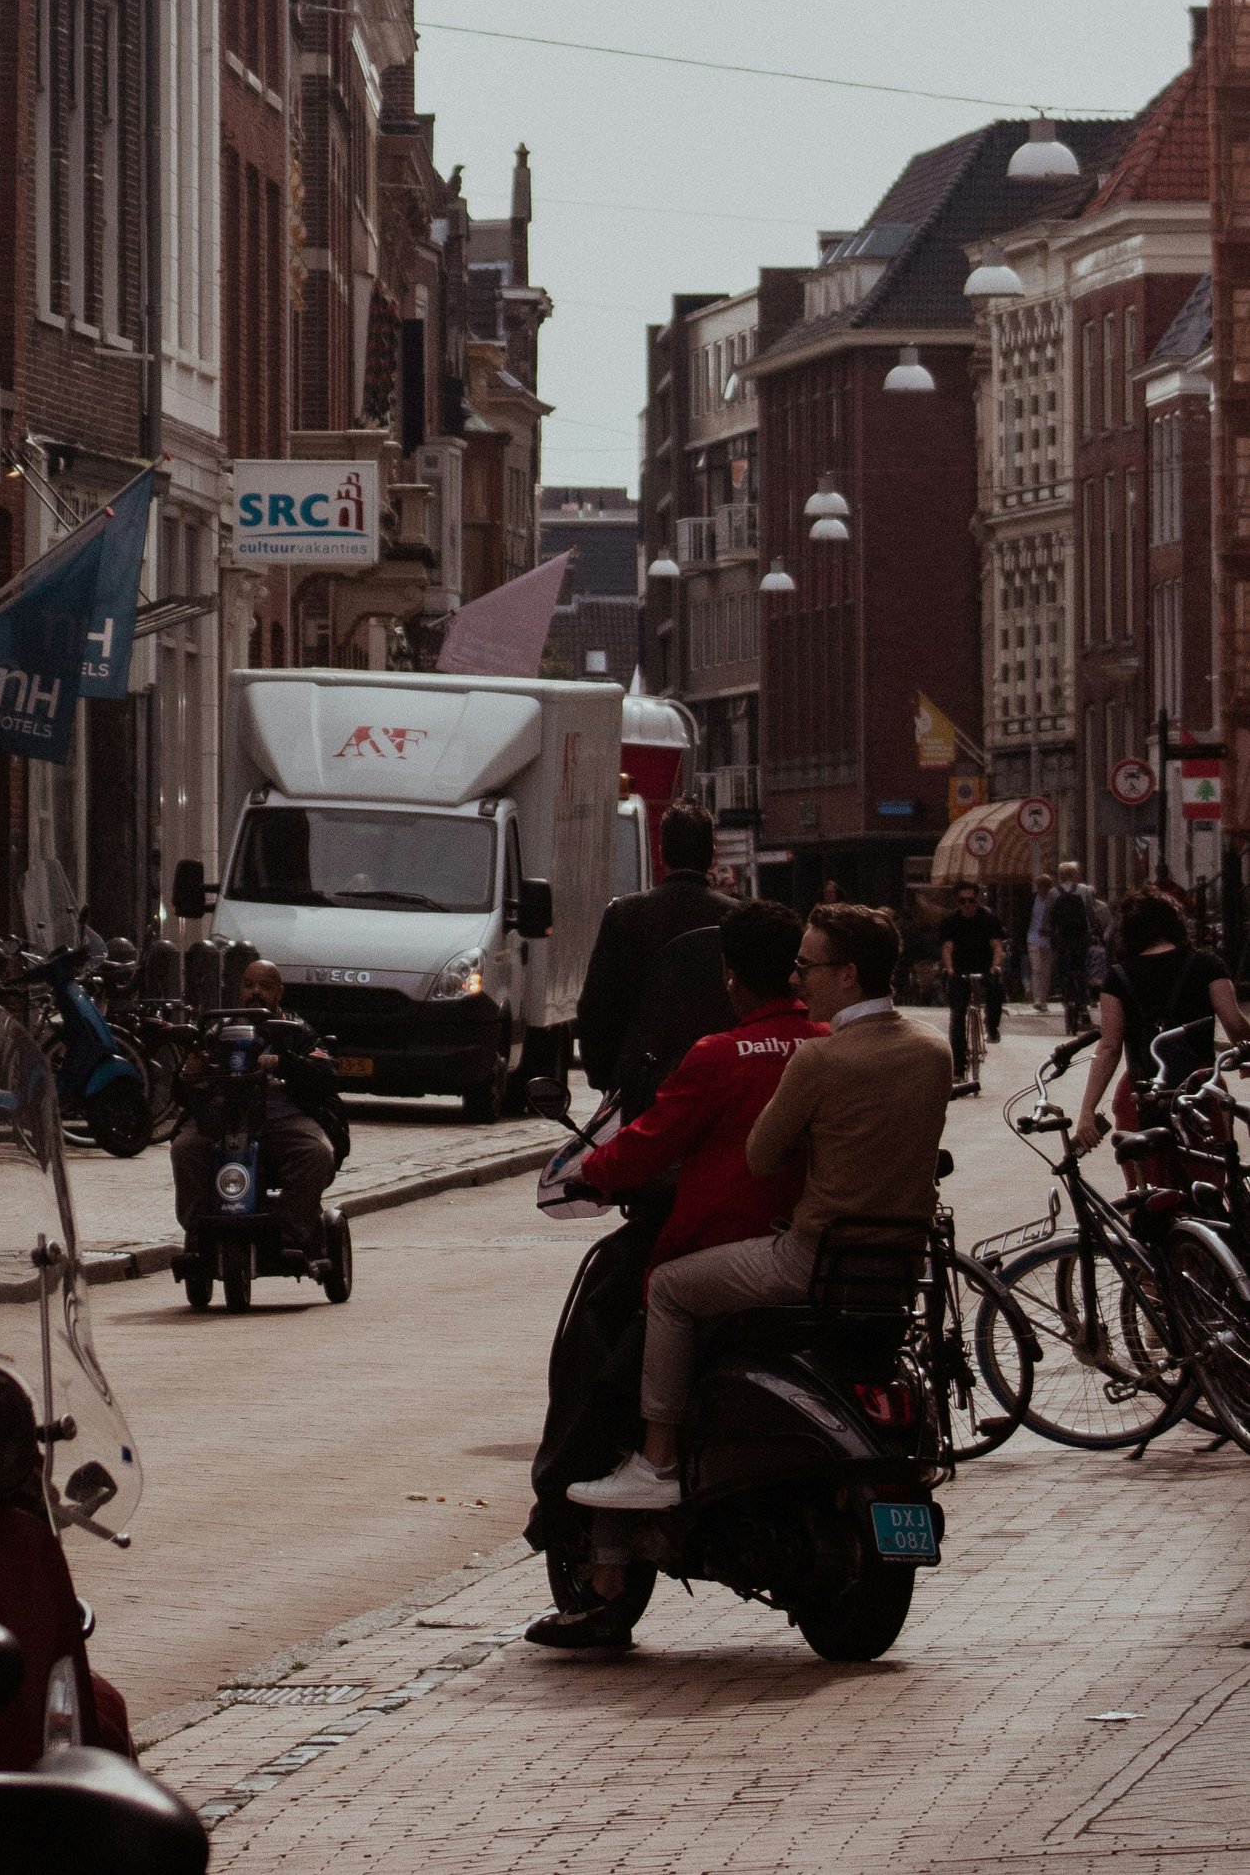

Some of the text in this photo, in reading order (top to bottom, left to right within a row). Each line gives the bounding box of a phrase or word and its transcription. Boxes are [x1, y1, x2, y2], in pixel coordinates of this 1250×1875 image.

[238, 492, 330, 528] SRC
[238, 541, 368, 556] cultuurvakanties
[80, 661, 110, 678] ELS
[304, 968, 372, 984] IVECO
[735, 1036, 792, 1057] Daily
[890, 1508, 926, 1528] DXJ
[894, 1530, 930, 1550] 08Z
